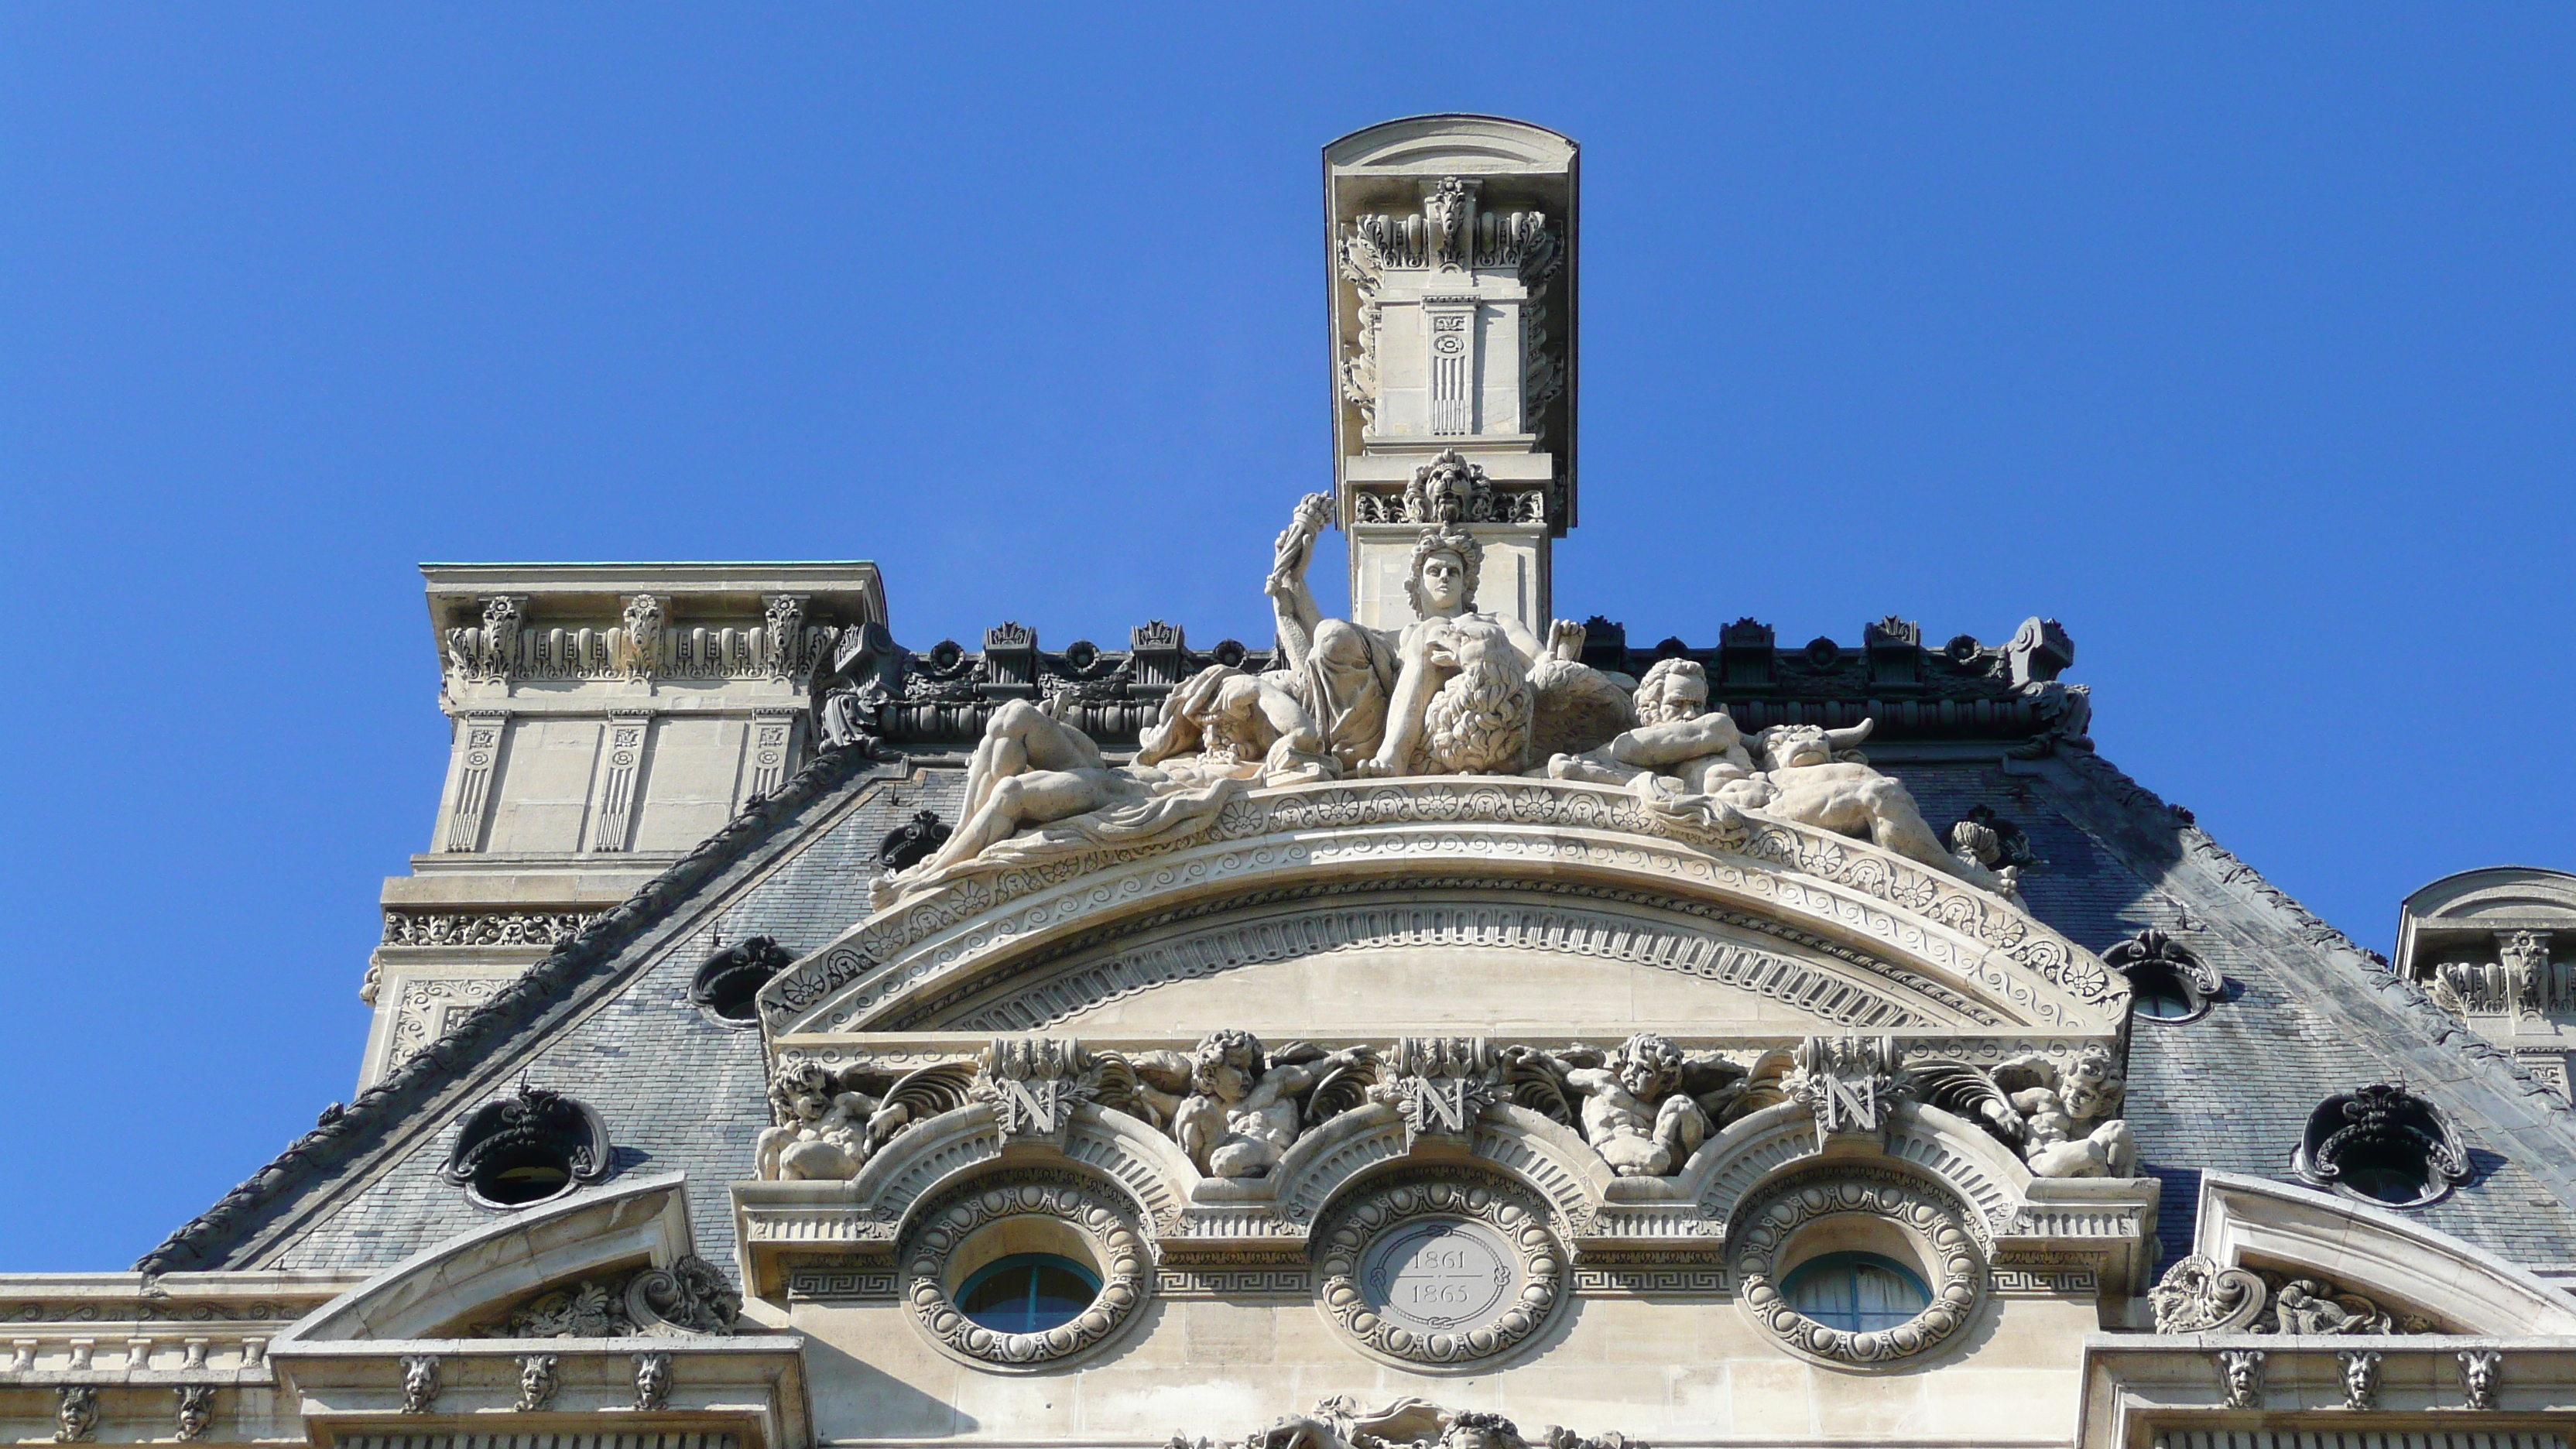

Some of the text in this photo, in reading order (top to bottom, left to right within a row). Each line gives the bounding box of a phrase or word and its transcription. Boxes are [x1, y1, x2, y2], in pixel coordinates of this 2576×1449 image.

[1005, 1080, 1058, 1134] N
[1414, 1077, 1465, 1133] N
[1824, 1076, 1875, 1132] N
[1413, 1250, 1464, 1269] 1861
[1413, 1284, 1469, 1303] 1865
